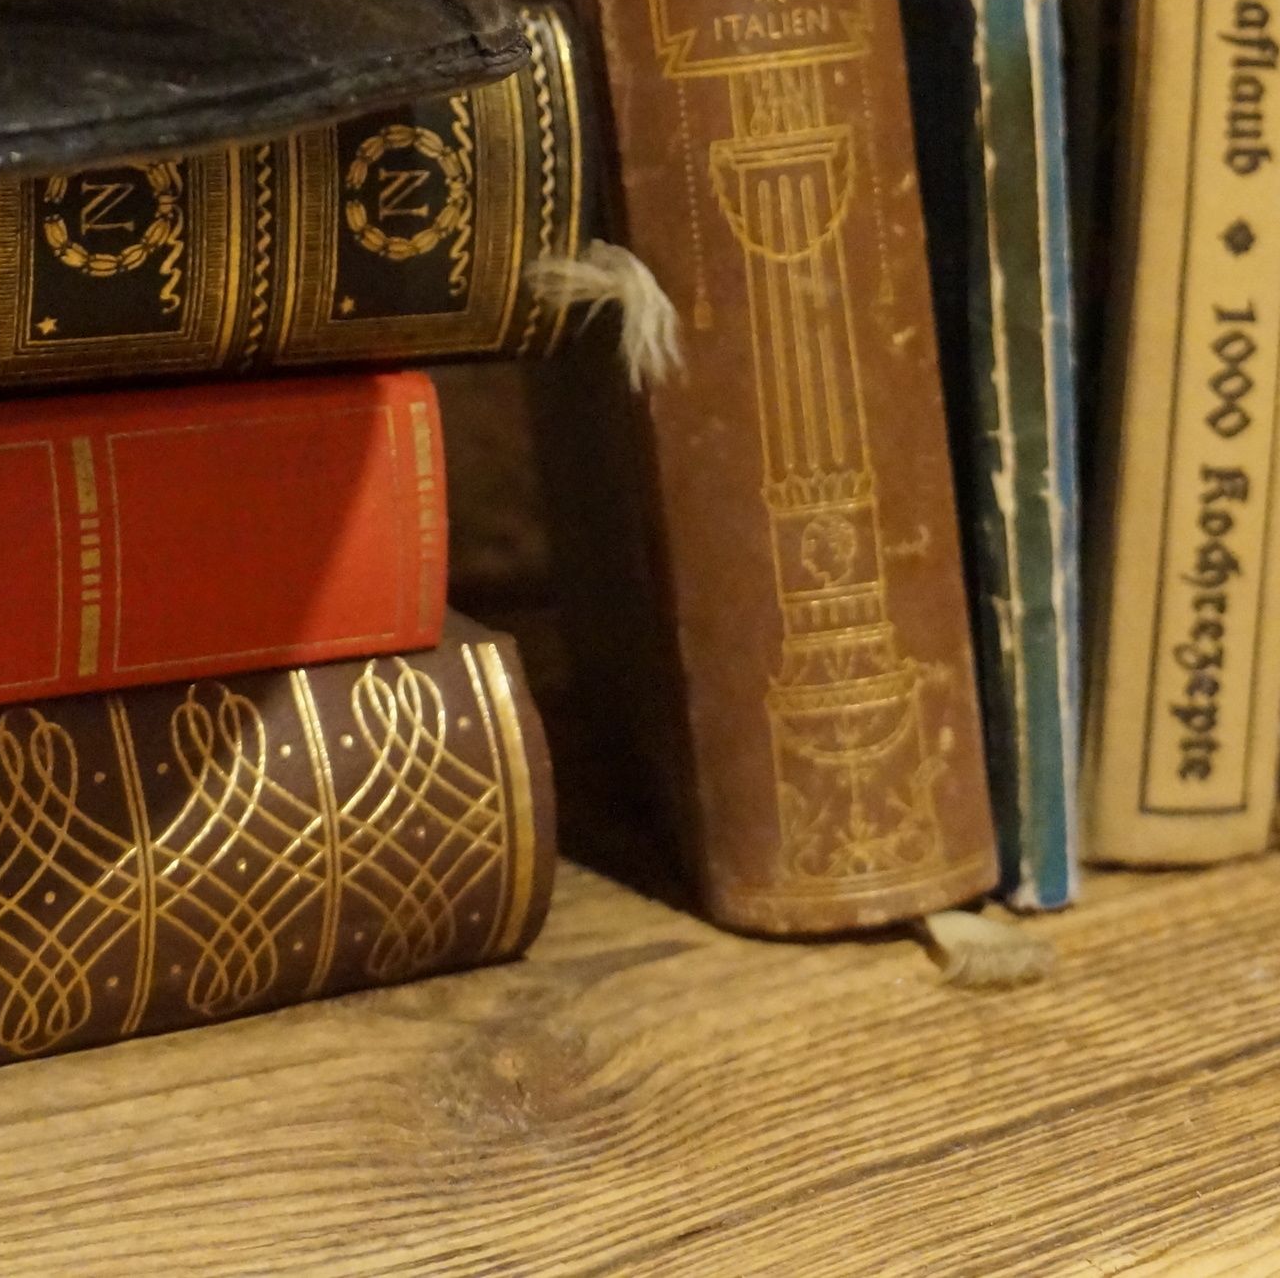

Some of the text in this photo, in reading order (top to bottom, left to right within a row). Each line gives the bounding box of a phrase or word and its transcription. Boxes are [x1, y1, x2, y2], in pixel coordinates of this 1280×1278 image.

[713, 3, 831, 42] ITALIEN
[1205, 300, 1258, 439] 1000
[1169, 464, 1250, 782] Kochrezepte
